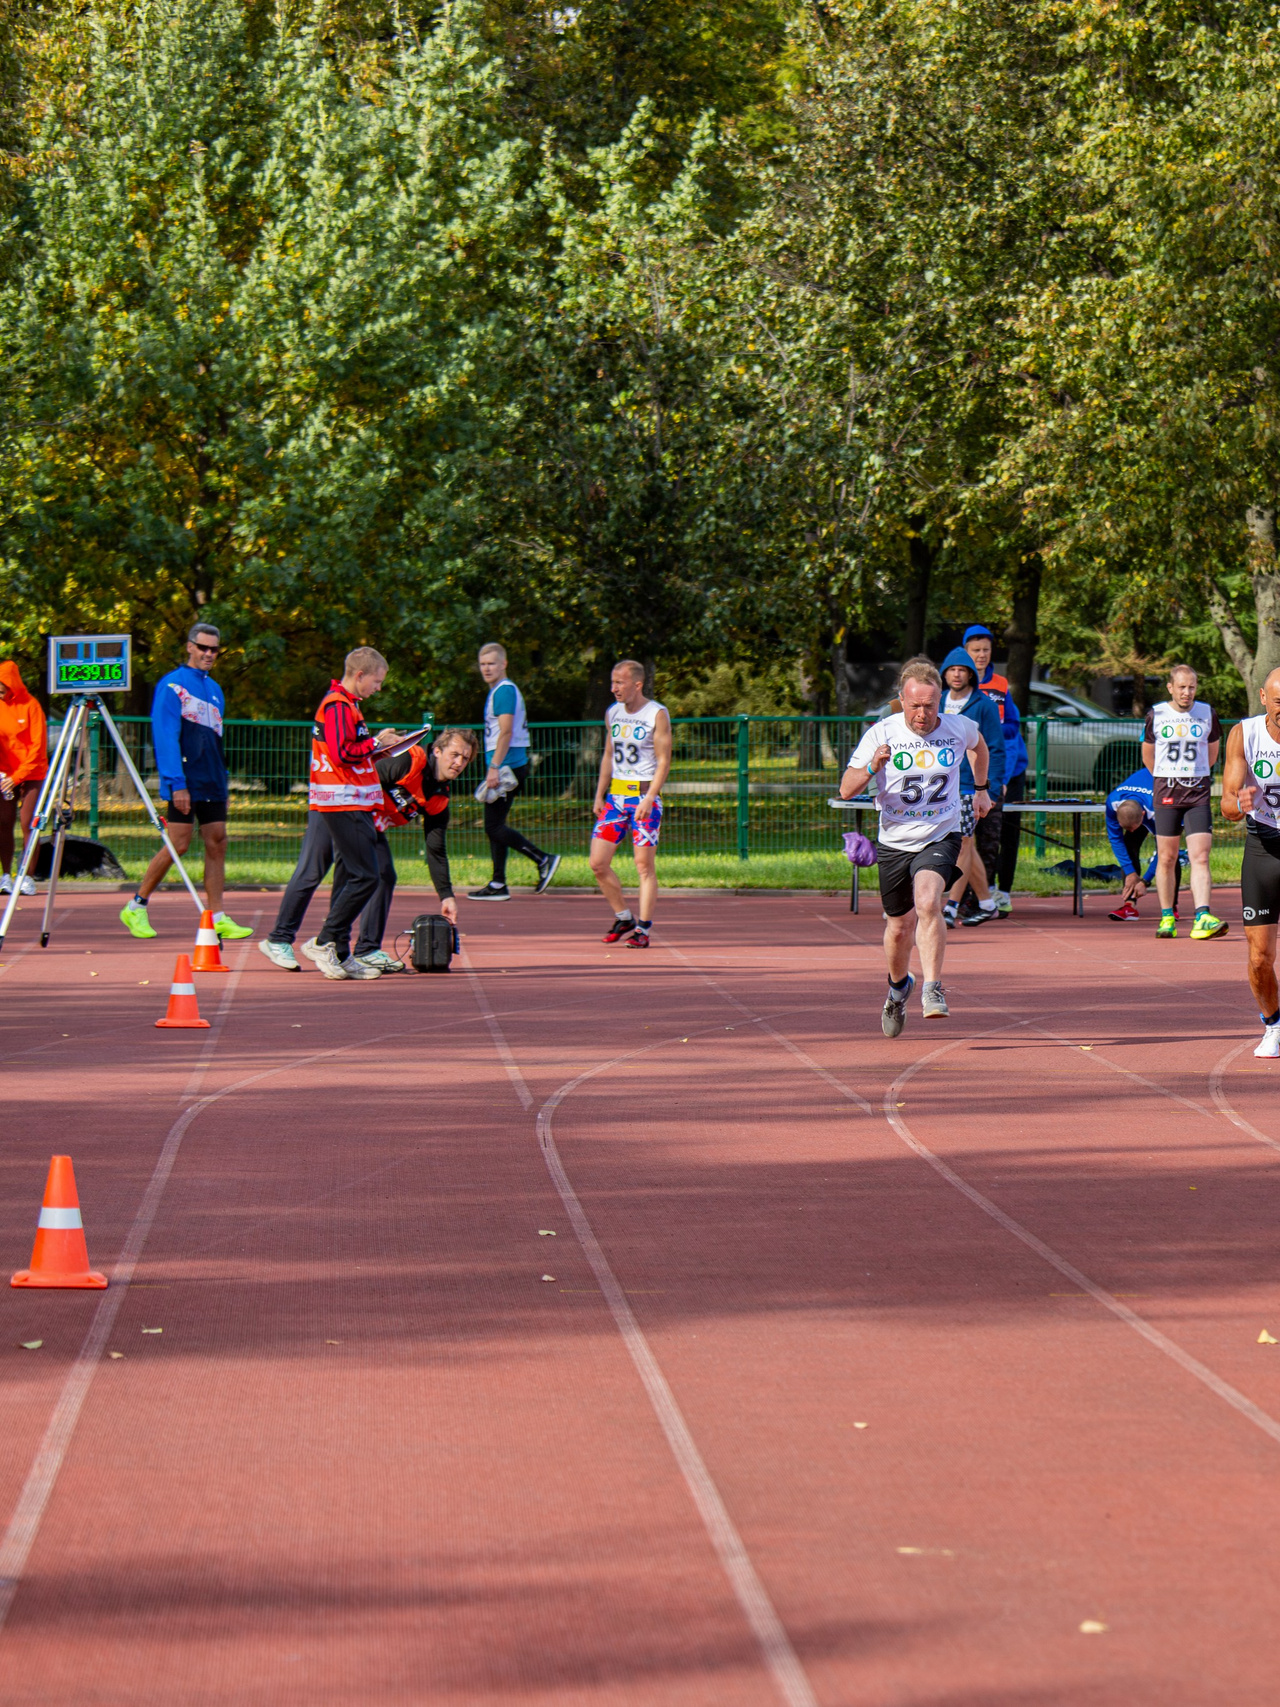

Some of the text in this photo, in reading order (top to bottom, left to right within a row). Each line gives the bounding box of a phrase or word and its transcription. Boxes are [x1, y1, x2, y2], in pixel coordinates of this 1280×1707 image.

[614, 741, 640, 765] 53
[892, 738, 956, 751] VMARAFONE
[1167, 740, 1197, 763] 55
[900, 773, 950, 807] 52
